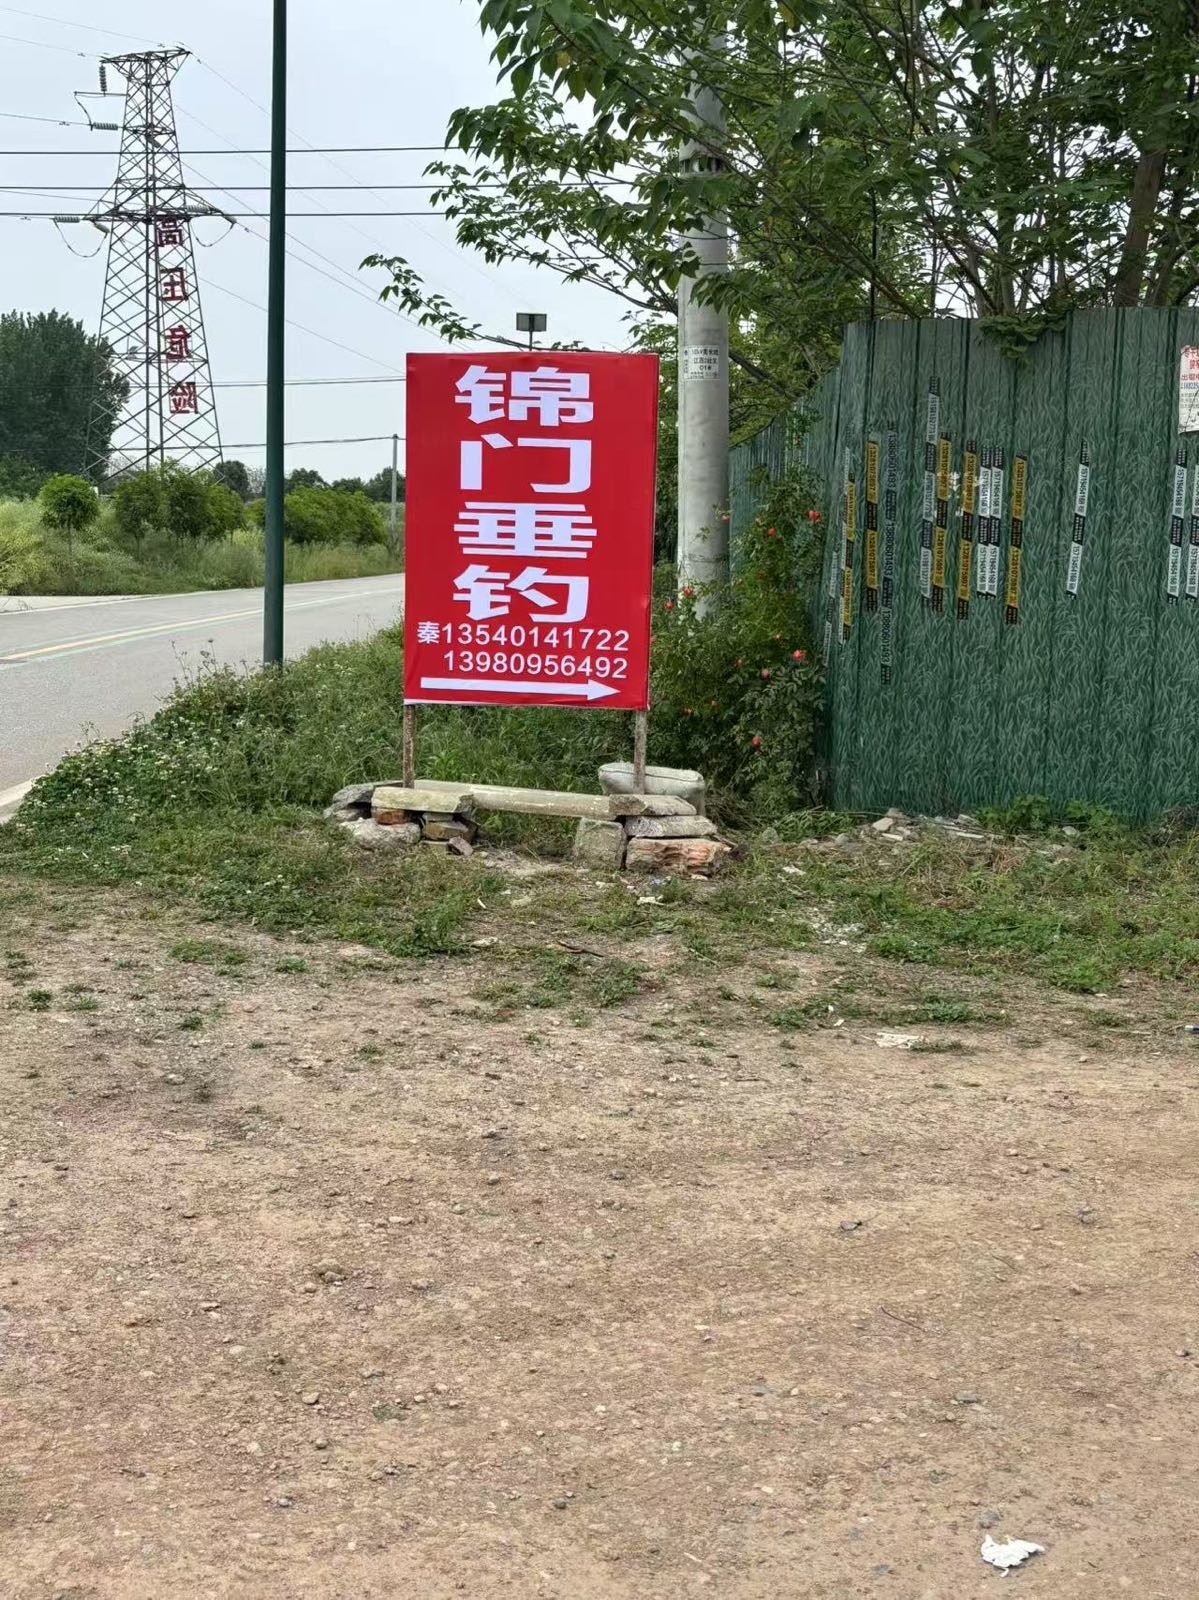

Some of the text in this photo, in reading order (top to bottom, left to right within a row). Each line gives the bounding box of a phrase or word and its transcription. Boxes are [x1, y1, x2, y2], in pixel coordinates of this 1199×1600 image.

[453, 365, 598, 624] 锦门垂钓
[416, 621, 630, 652] 秦13540141722
[443, 651, 628, 679] 13980956492
